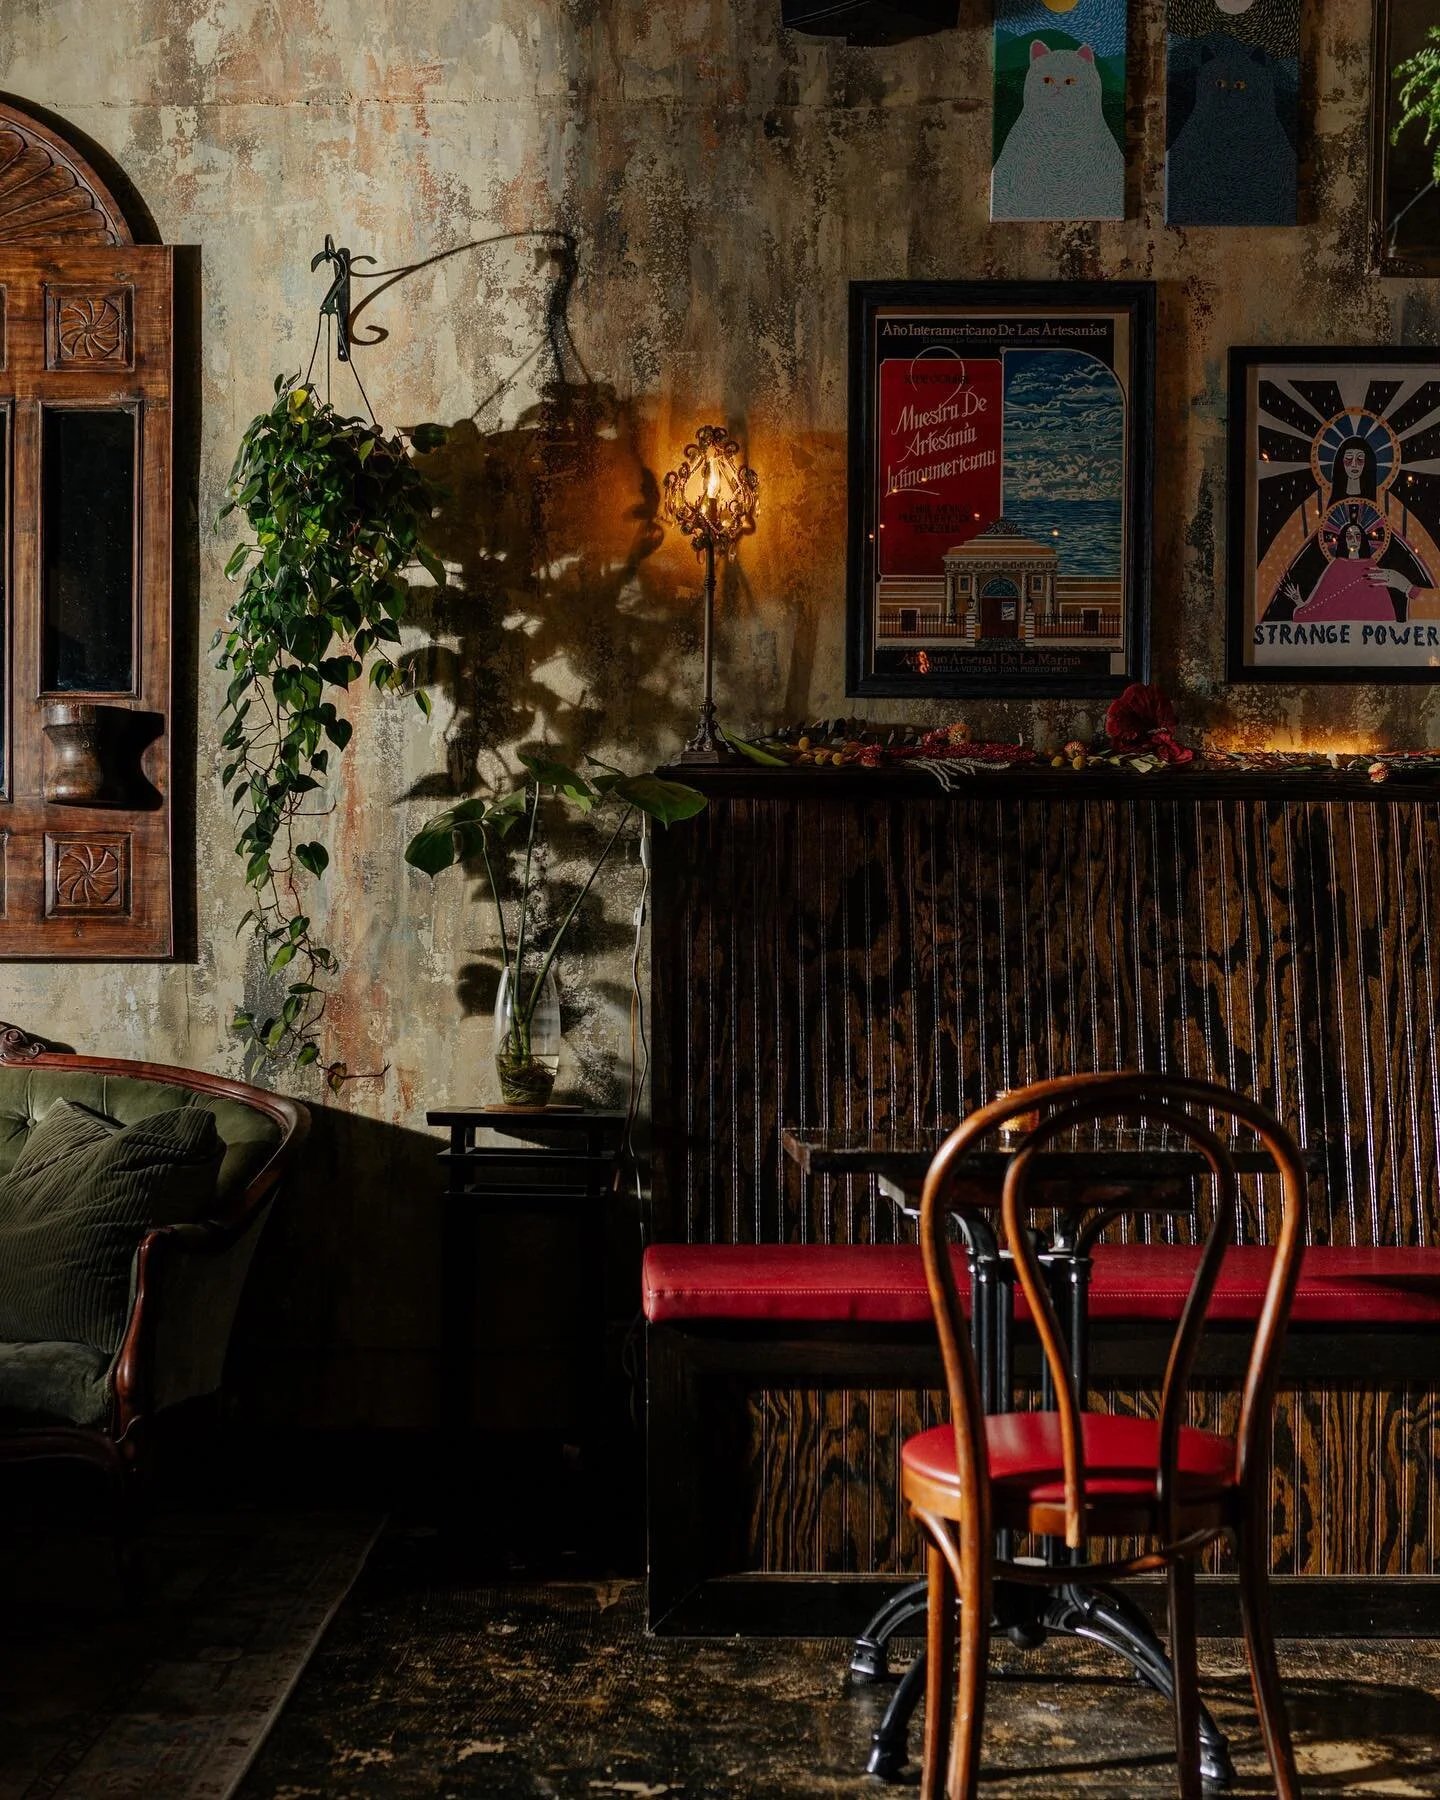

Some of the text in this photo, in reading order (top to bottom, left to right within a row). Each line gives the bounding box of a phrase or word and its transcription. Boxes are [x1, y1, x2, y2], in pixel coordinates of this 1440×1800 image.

[881, 321, 908, 336] Año
[909, 324, 997, 336] Interamericano
[997, 324, 1015, 336] De
[1016, 323, 1039, 336] Las
[891, 385, 987, 435] Muestra De
[884, 449, 996, 498] Latinoamericana
[1253, 624, 1440, 646] STRANGE POWER
[950, 652, 997, 665] Arsenal
